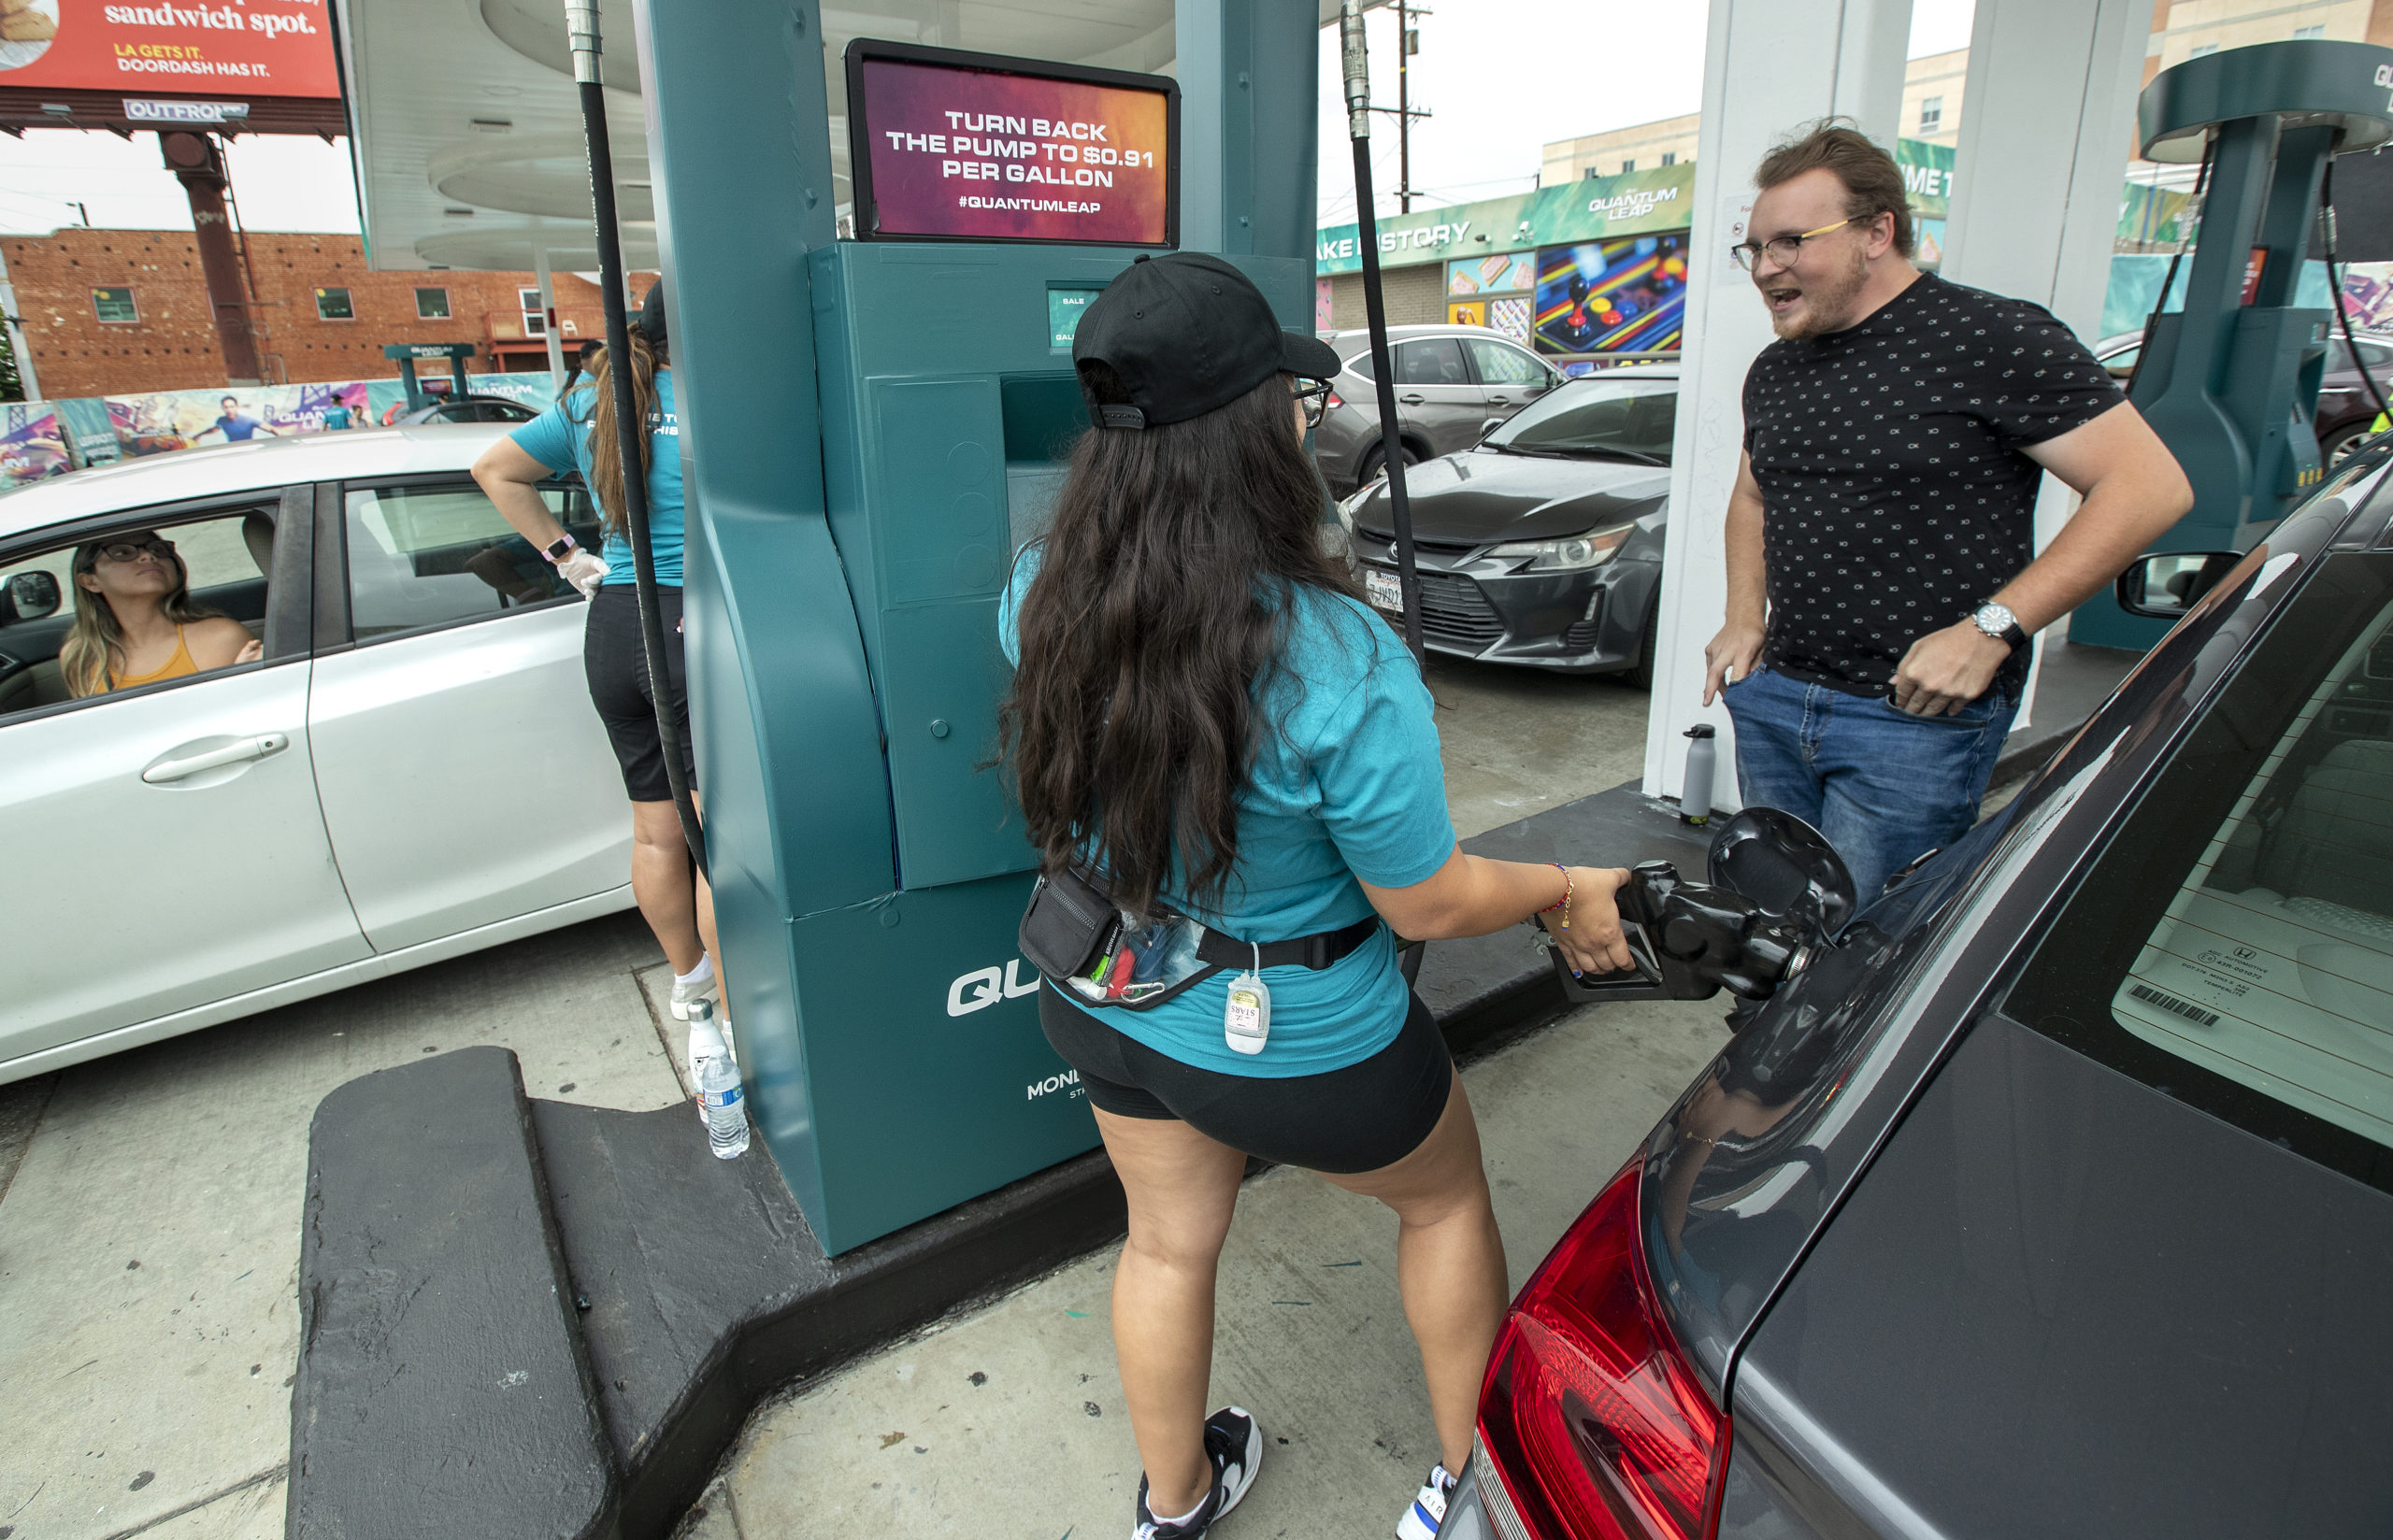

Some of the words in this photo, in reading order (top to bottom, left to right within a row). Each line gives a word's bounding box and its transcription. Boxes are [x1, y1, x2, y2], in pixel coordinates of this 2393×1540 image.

[105, 2, 245, 30] sandwich
[250, 12, 317, 38] spot.
[113, 43, 137, 57] LA
[140, 45, 183, 59] GETS
[186, 47, 204, 60] IT.
[117, 58, 213, 75] DOORDASH
[216, 63, 251, 77] HAS
[252, 64, 270, 78] IT.
[945, 110, 1026, 135] TURN
[1033, 119, 1108, 141] BACK
[886, 132, 947, 153] THE
[953, 136, 1037, 159] PUMP
[1042, 143, 1078, 163] TO
[1083, 145, 1154, 168] $0.91
[943, 161, 999, 180] PER
[1006, 164, 1113, 187] GALLON
[958, 195, 1100, 213] #QUANTUMLEAP
[1588, 186, 1678, 213] QUANTUM
[1608, 204, 1654, 221] LEAP
[1357, 221, 1471, 255] STORY
[279, 411, 324, 422] QUAN
[947, 959, 1041, 1018] QU
[1425, 1495, 1443, 1515] AIR
